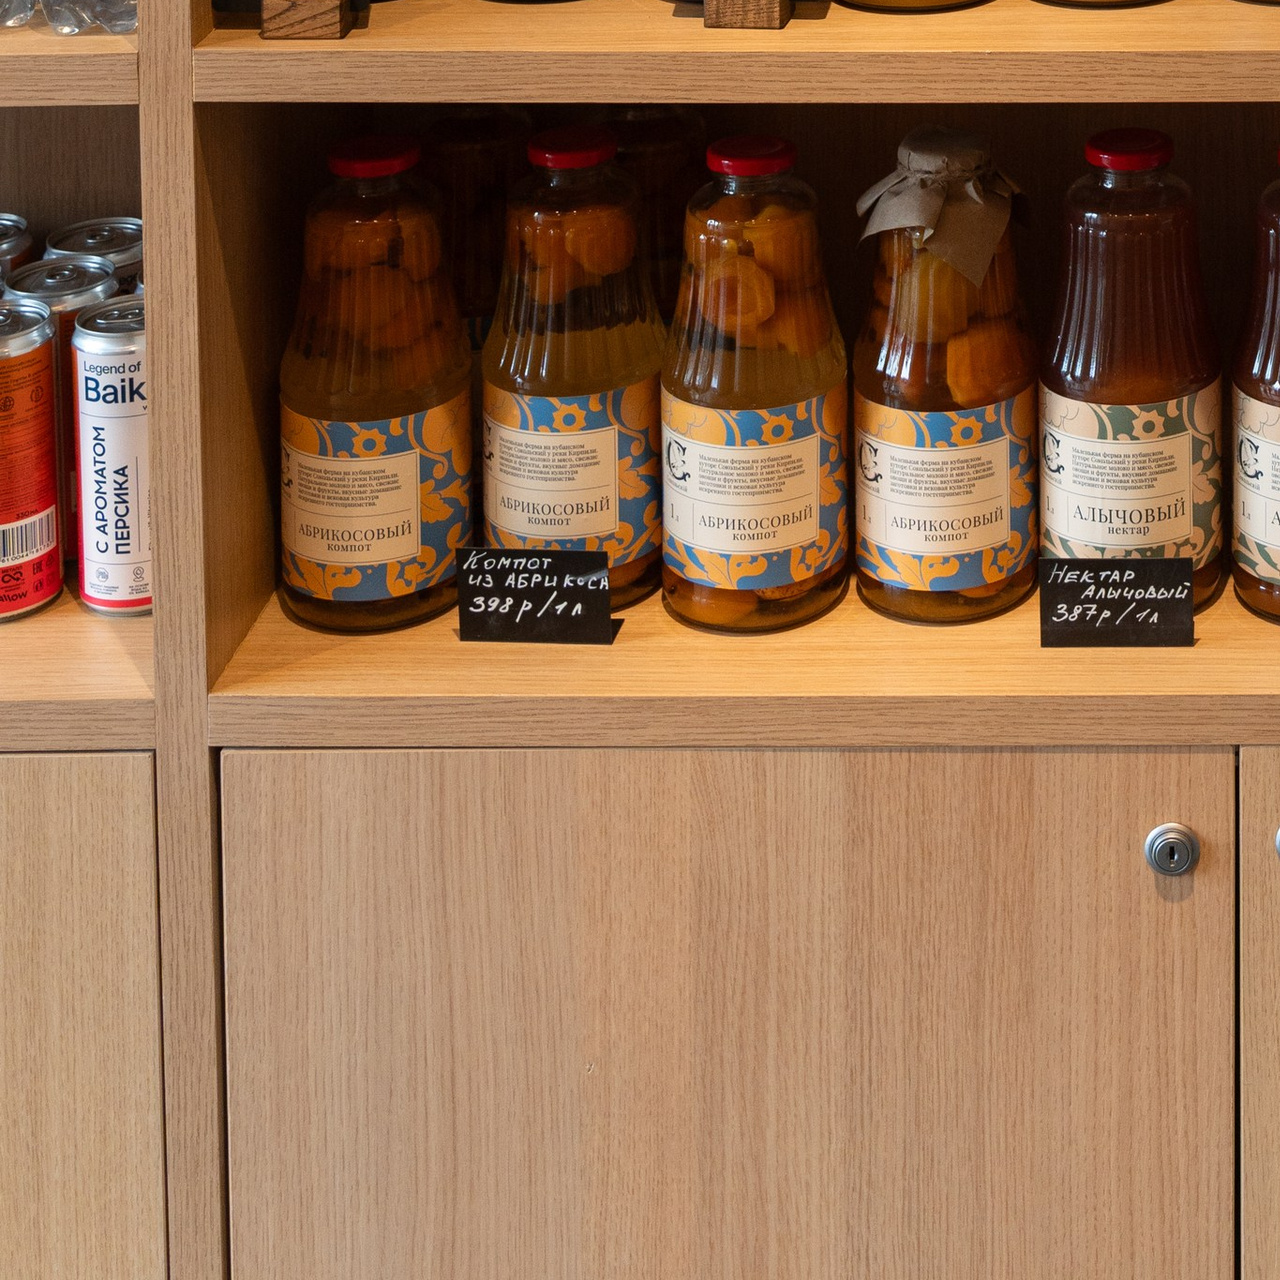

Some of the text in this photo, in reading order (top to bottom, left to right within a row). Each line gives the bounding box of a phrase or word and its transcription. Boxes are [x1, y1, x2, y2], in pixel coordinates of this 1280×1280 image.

[84, 360, 141, 375] Legend of
[84, 377, 146, 404] Baik
[92, 426, 109, 553] С АРОМАТОМ
[113, 464, 130, 554] ПЕРСИКА
[500, 496, 610, 516] АБРИКОСОВЫЙ
[1073, 499, 1186, 524] АЛЫЧОВЫЙ
[699, 504, 813, 531] АБРИКОСОВЫЙ
[891, 506, 1004, 532] АБРИКОСОВЫЙ
[299, 520, 412, 542] АБРИКОСОВЫЙ
[1108, 524, 1150, 537] нектар
[462, 550, 552, 571] КОМПОТ
[1048, 563, 1136, 583] НЕКТАР
[1081, 582, 1191, 601] АЛЫЧОВЫЙ
